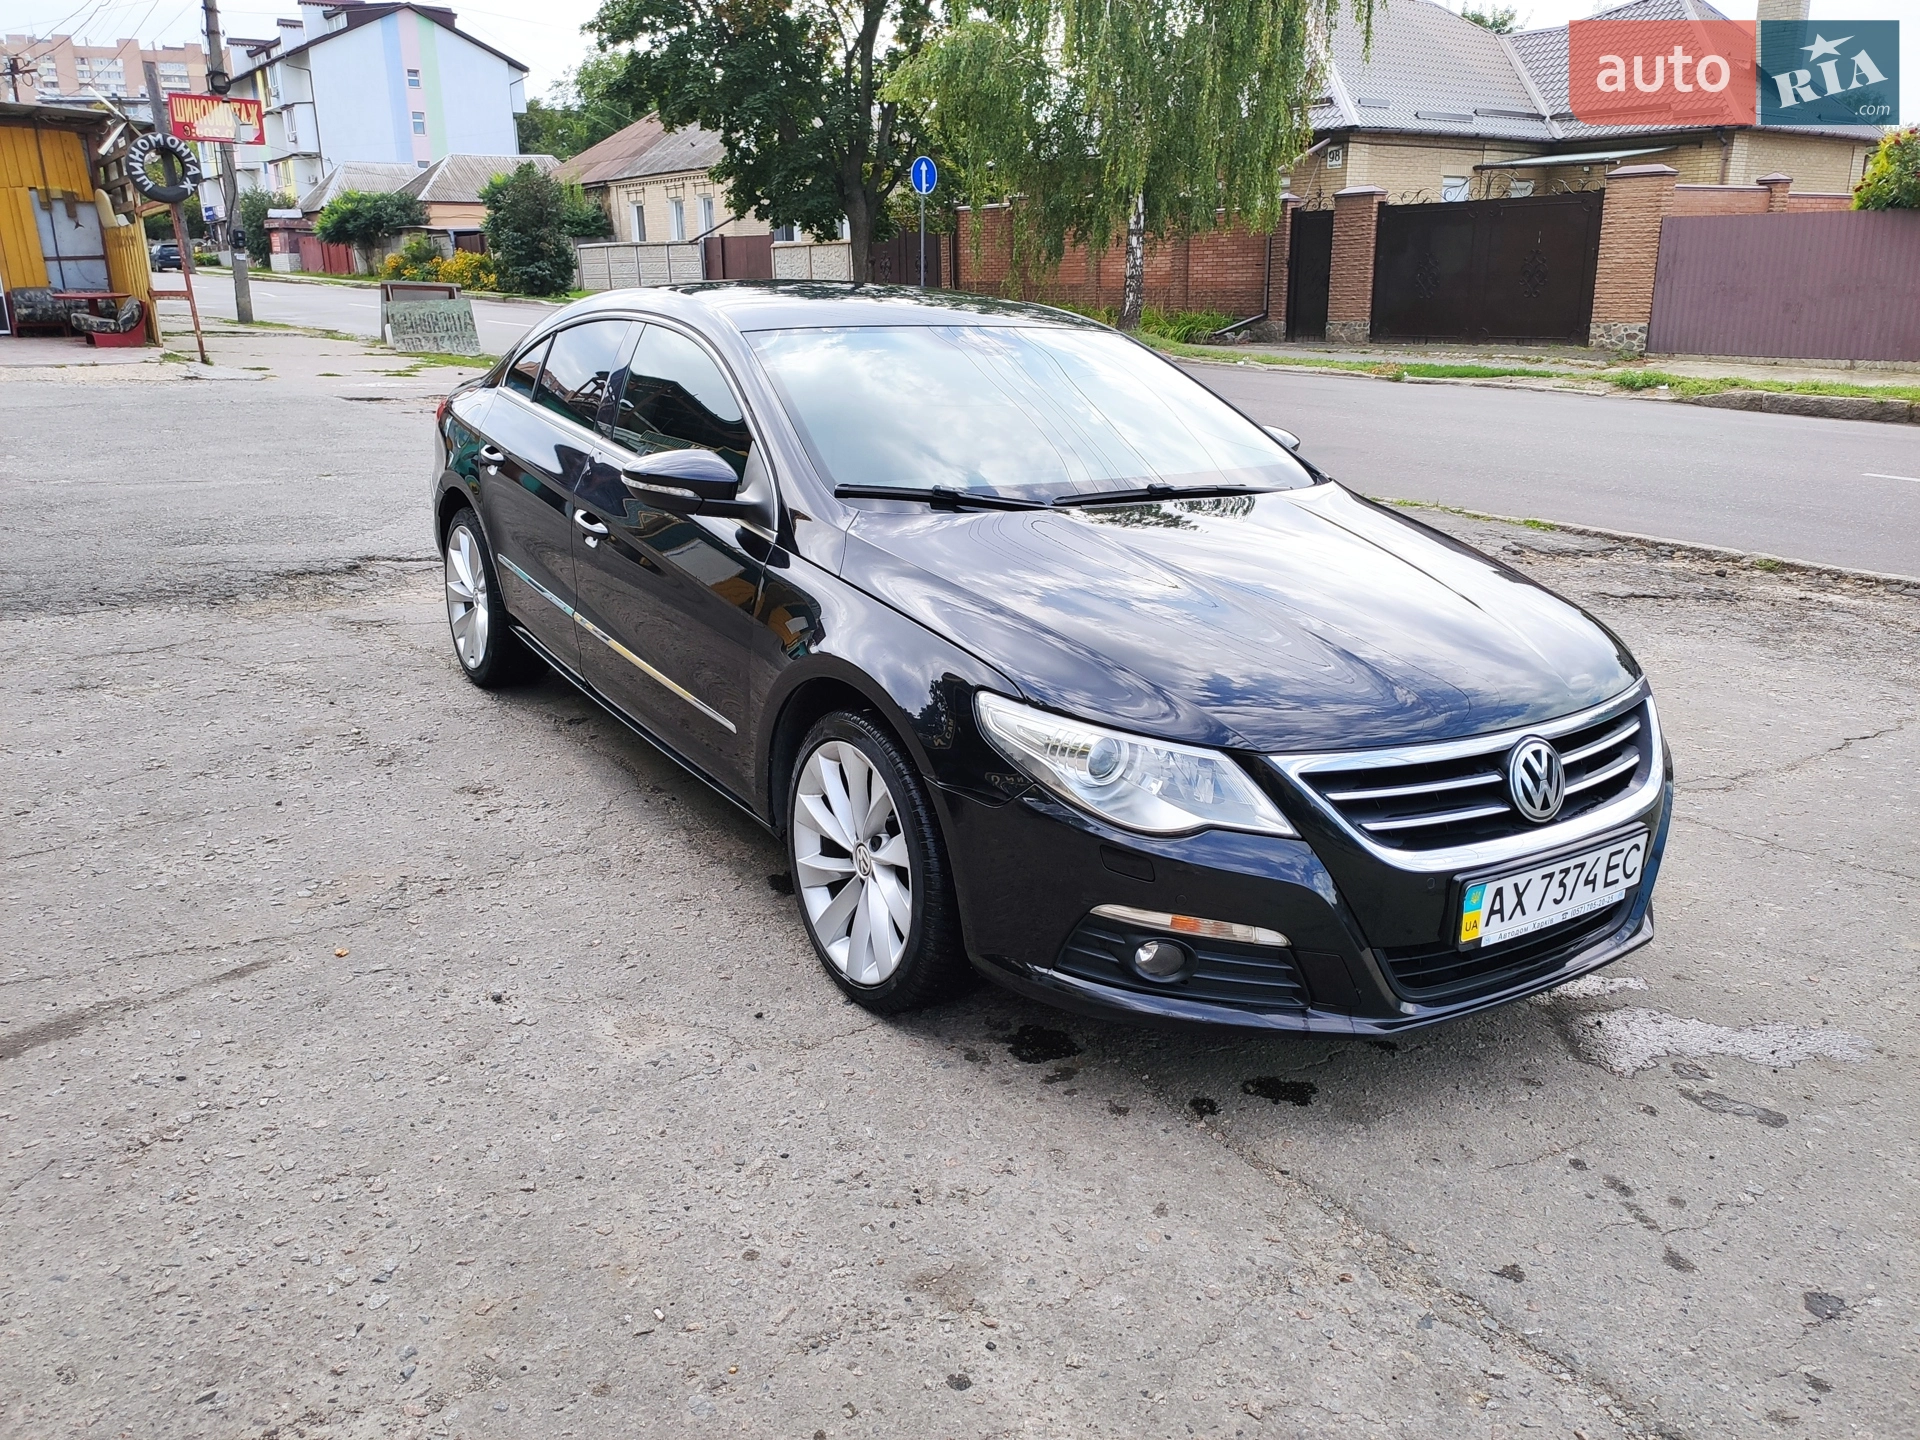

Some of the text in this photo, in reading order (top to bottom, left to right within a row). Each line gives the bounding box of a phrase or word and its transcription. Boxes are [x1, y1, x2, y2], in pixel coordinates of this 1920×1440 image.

[128, 133, 200, 196] ШИНОМОНТАЖ
[1328, 150, 1341, 162] 98
[1484, 843, 1641, 928] AX 7374 EC
[1465, 919, 1479, 932] UA
[1497, 926, 1529, 941] Автодом
[1532, 917, 1554, 930] Харків
[1570, 905, 1586, 917] (057)
